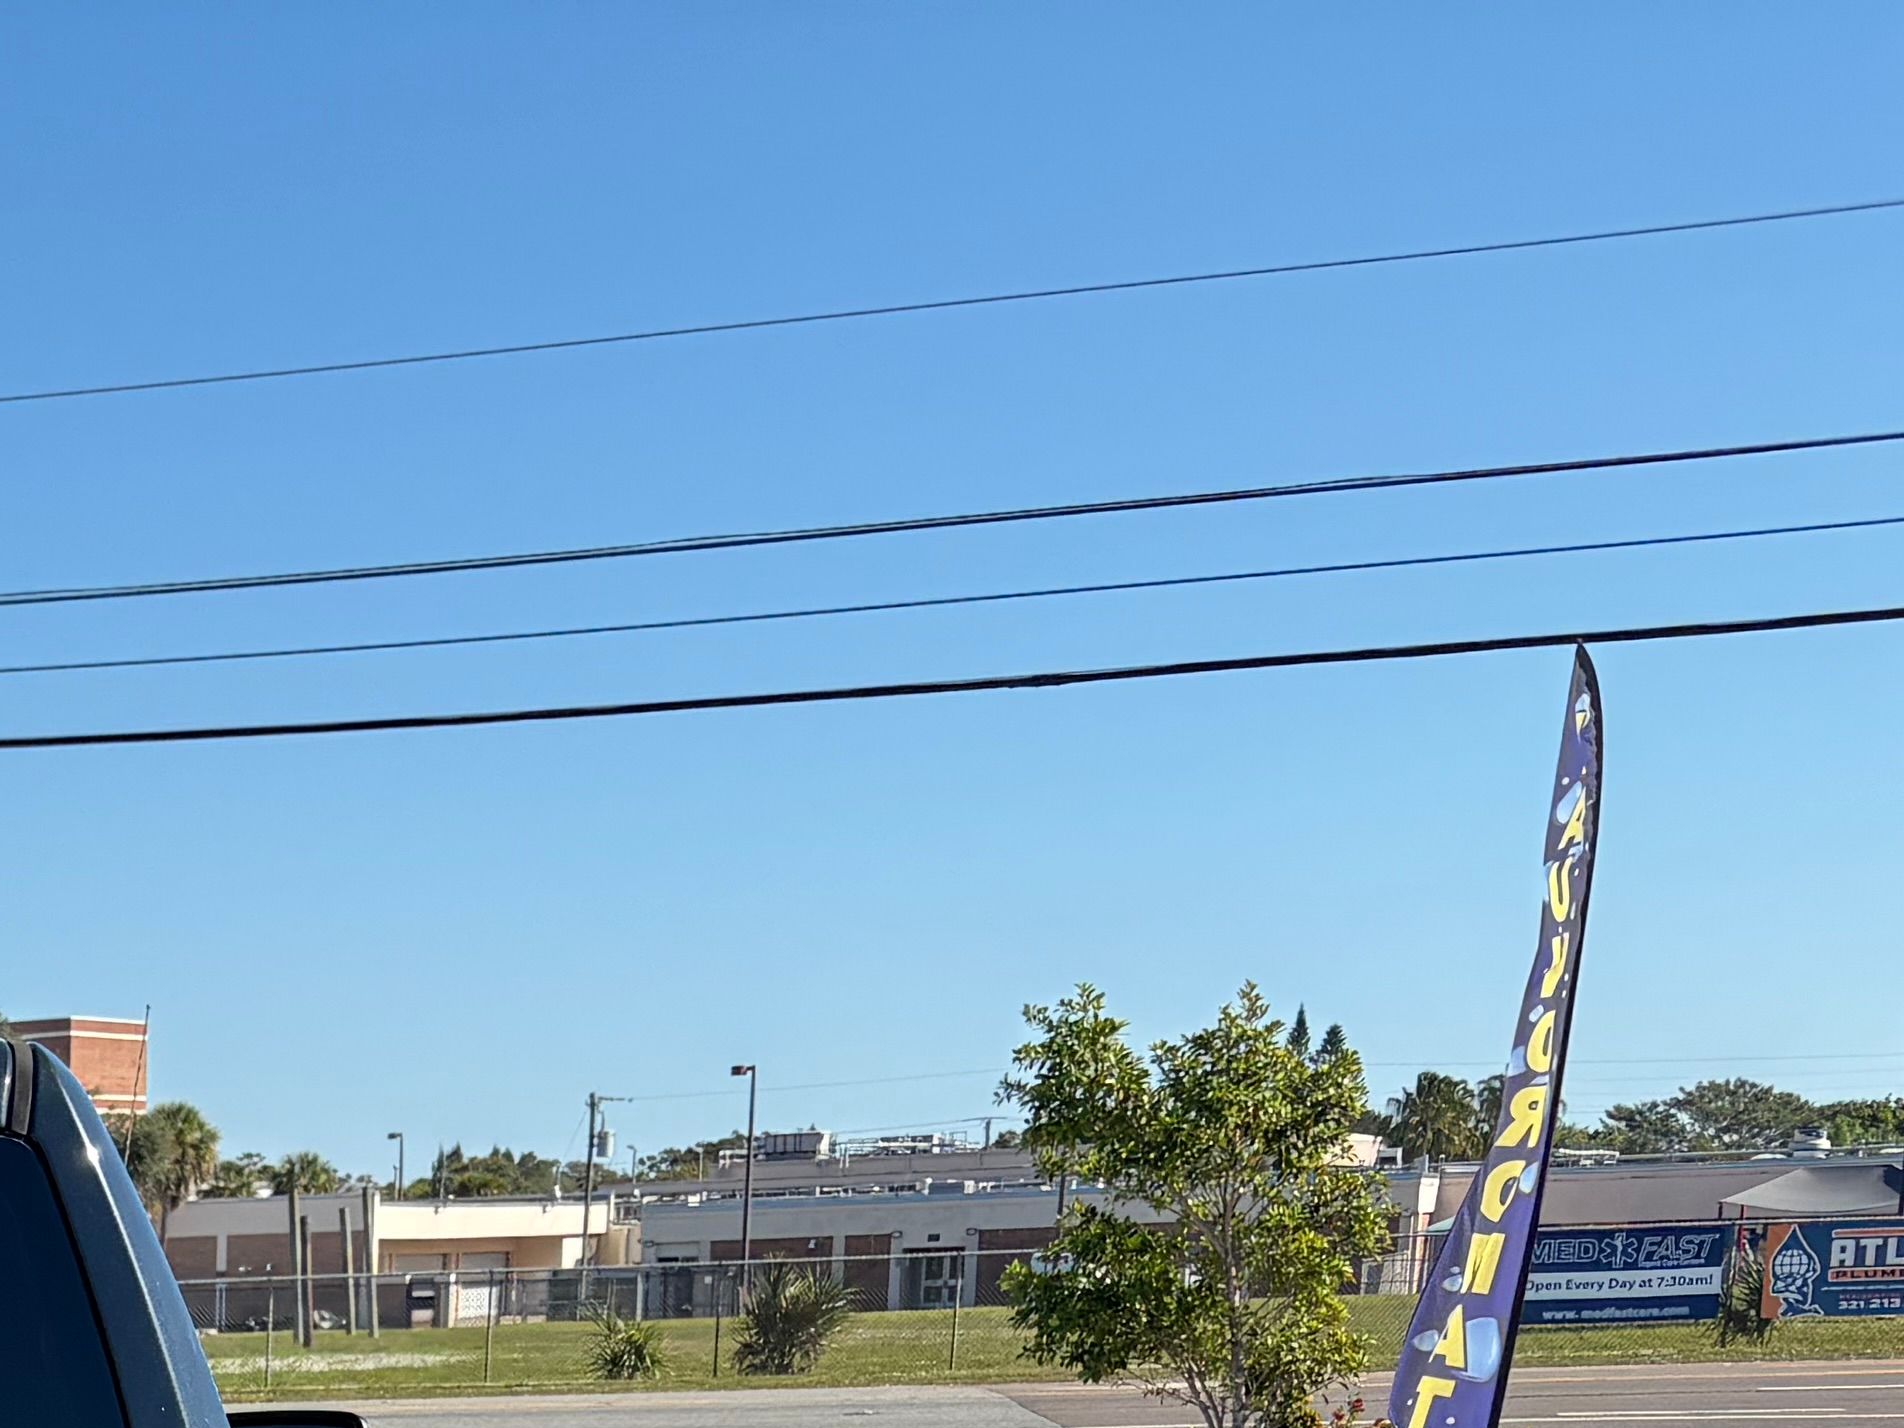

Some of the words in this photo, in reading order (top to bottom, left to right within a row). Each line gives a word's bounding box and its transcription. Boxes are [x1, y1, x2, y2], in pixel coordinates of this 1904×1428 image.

[1532, 1238, 1599, 1264] MED
[1638, 1233, 1720, 1268] FAST
[1565, 1278, 1605, 1292] Every
[1608, 1277, 1636, 1291] Day
[1638, 1279, 1653, 1288] at
[1656, 1273, 1713, 1289] 7:30am!
[1834, 1269, 1904, 1280] PLUM
